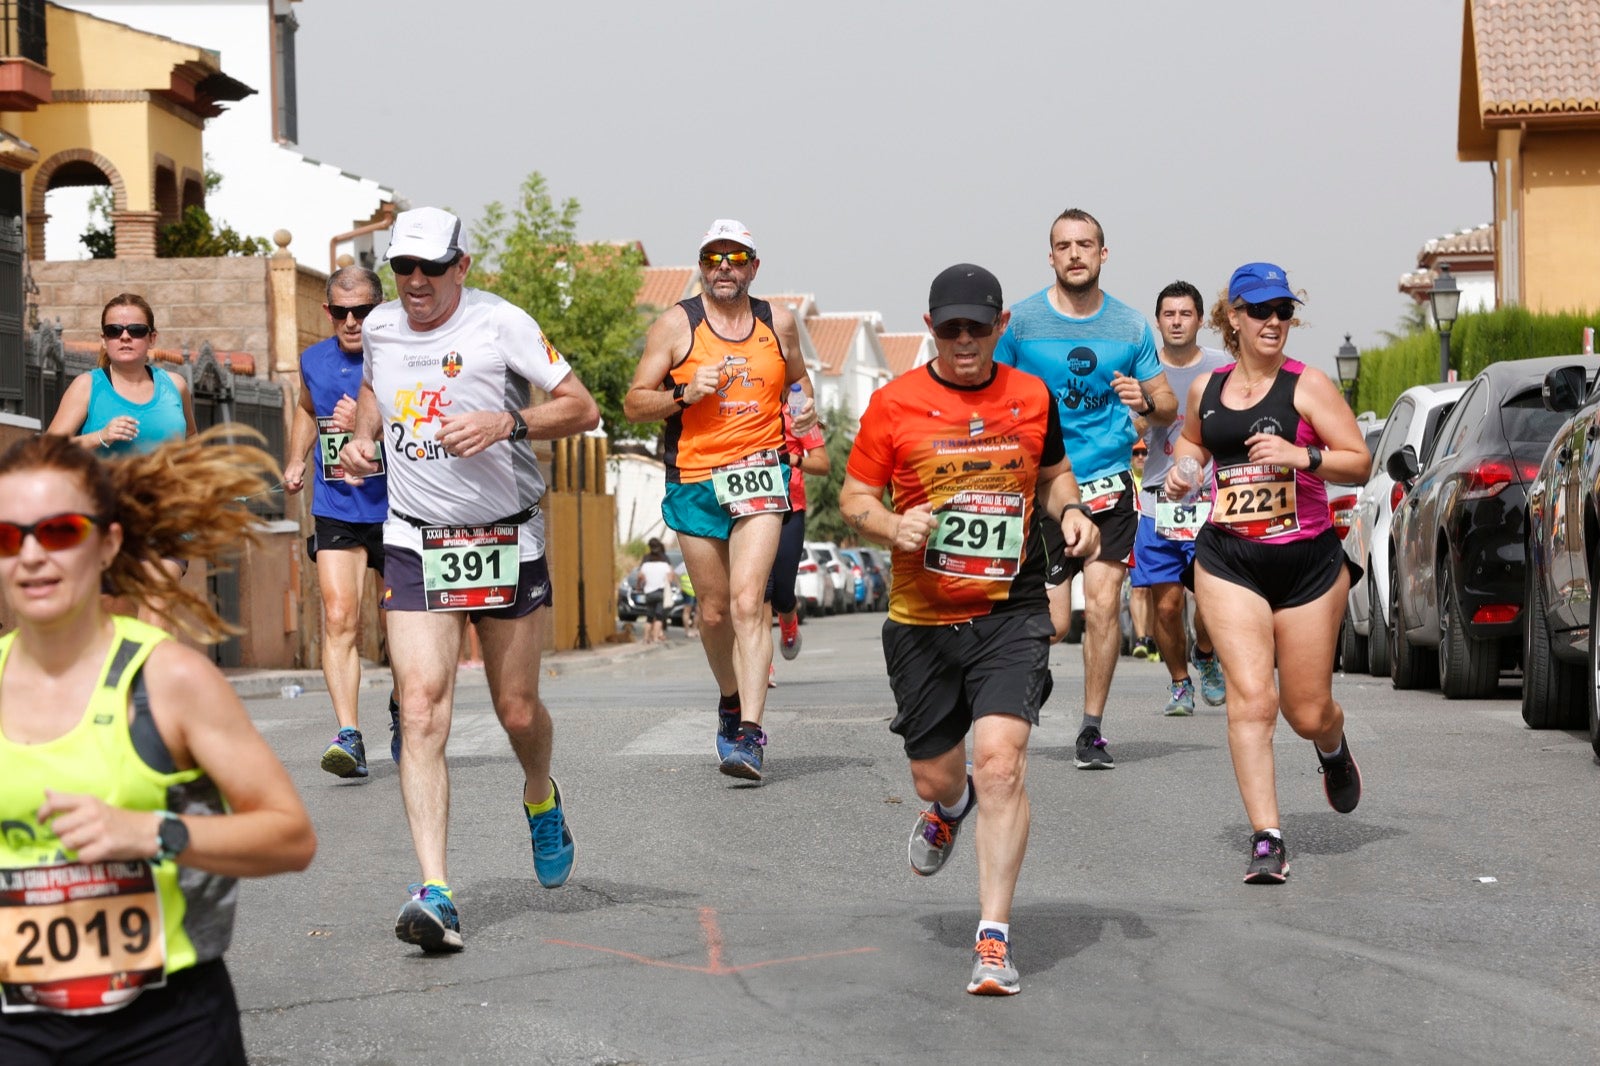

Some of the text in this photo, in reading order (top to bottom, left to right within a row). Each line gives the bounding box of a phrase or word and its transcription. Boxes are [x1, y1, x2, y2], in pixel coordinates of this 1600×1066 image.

[408, 358, 440, 367] armadas
[726, 469, 773, 496] 880
[953, 493, 971, 505] GRAN
[972, 493, 994, 505] PREMIO
[995, 494, 1002, 506] DE
[1003, 495, 1020, 507] FONDO
[1225, 487, 1287, 516] 2221
[426, 528, 442, 540] XXXII
[493, 526, 514, 536] FONDO
[943, 516, 1007, 550] 291
[440, 549, 501, 583] 391
[15, 907, 151, 966] 2019
